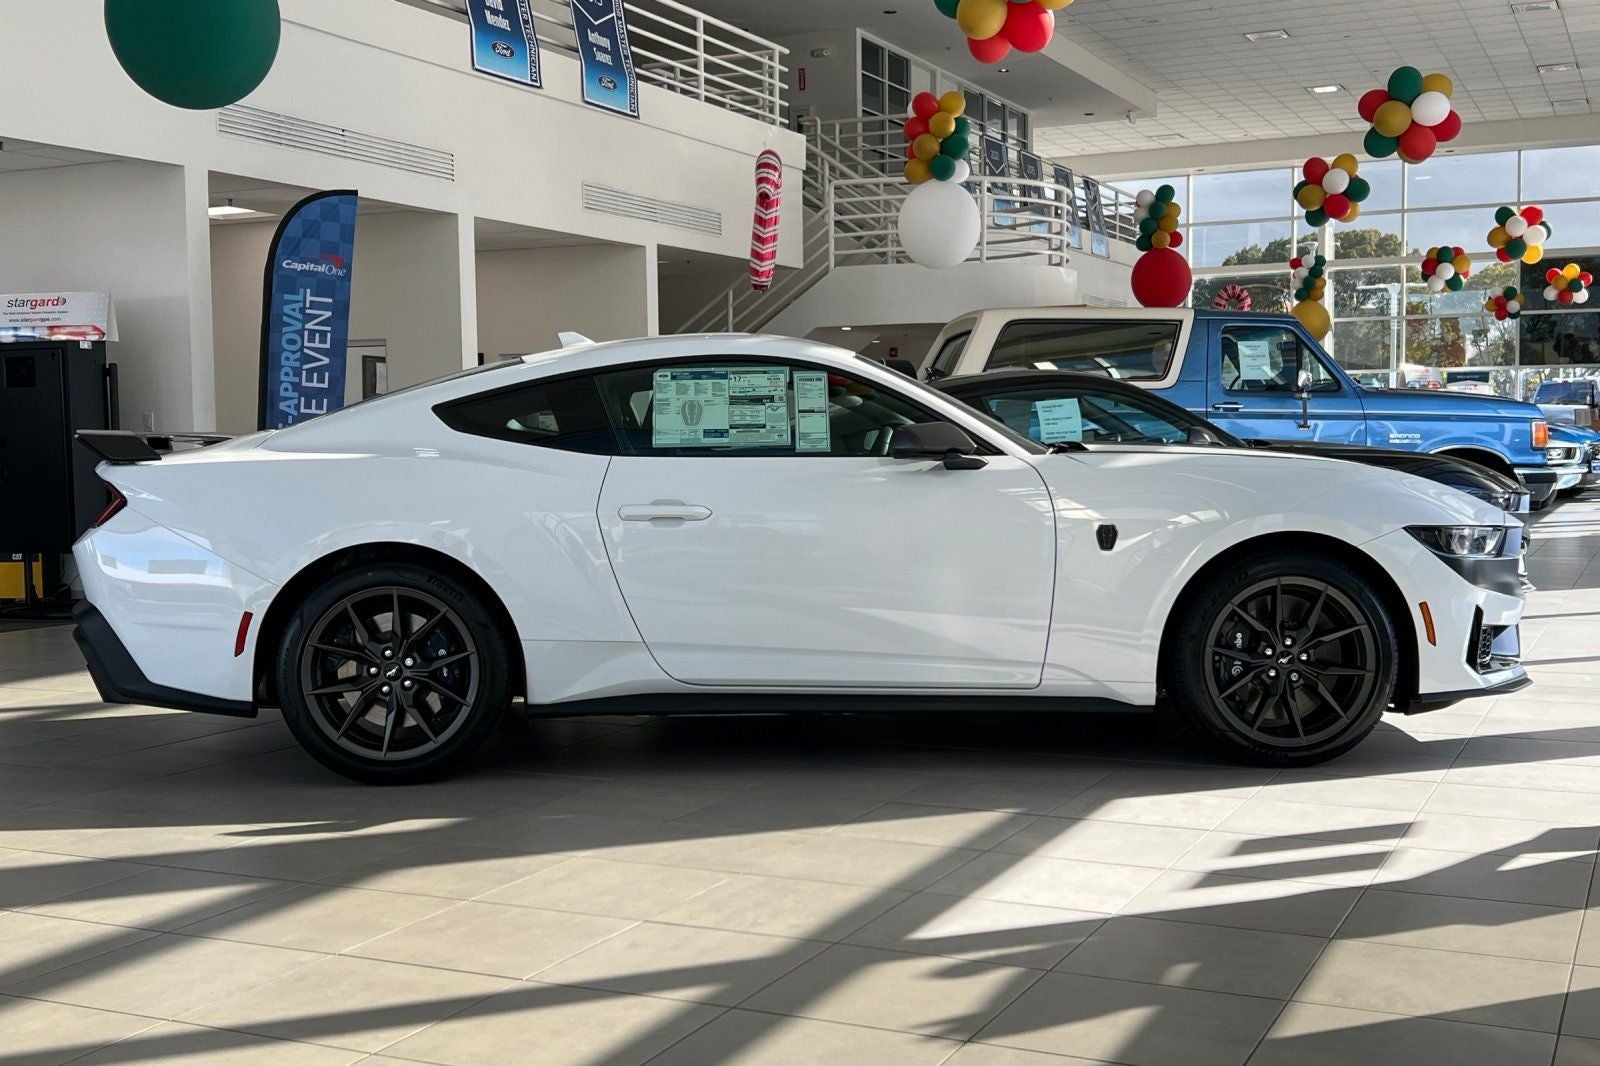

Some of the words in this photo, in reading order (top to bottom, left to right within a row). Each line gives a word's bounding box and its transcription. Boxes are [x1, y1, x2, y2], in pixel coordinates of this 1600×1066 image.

[484, 9, 511, 31] Mendez
[588, 28, 611, 51] Anthony
[525, 24, 537, 80] TECHNICIAN
[617, 20, 629, 55] MASTER
[625, 59, 636, 110] TECHNICIAN
[7, 296, 60, 309] stargard
[302, 288, 333, 388] EVENT
